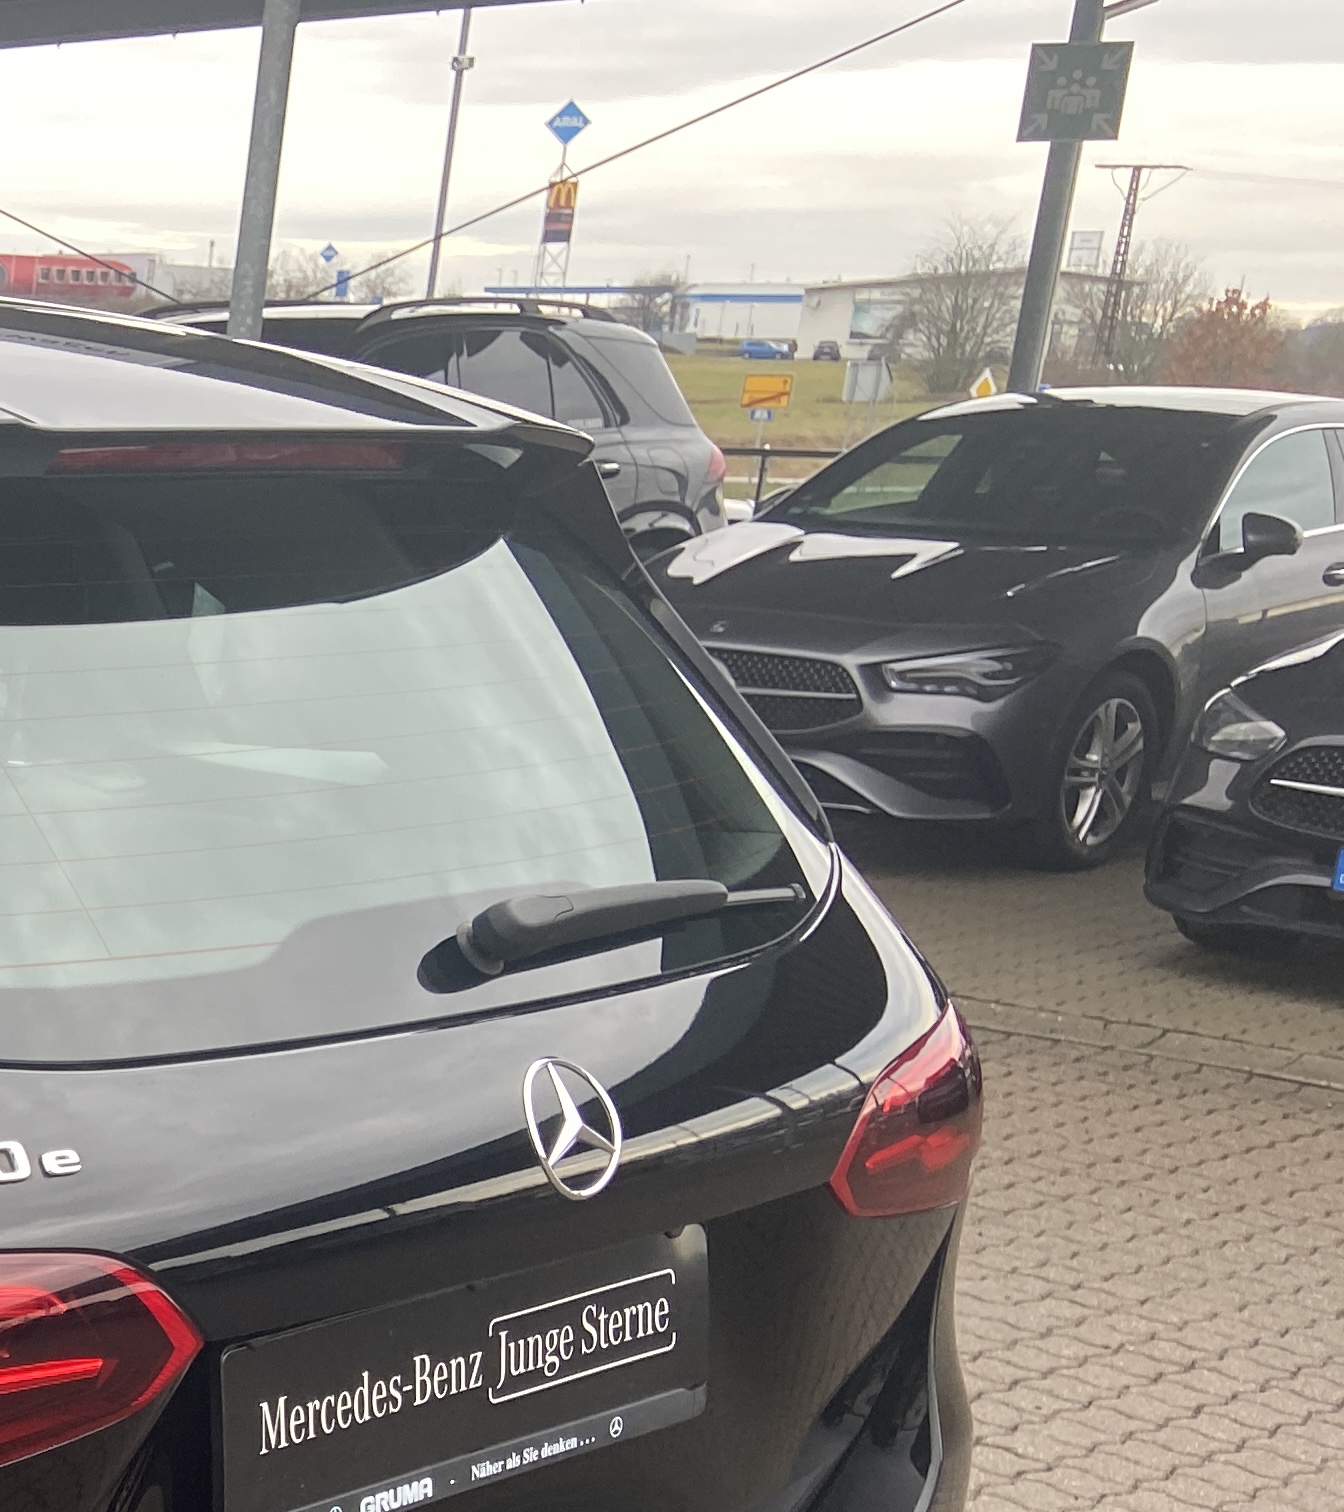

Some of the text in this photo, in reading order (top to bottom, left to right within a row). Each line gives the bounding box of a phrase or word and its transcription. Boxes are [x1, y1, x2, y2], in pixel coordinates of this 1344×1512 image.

[259, 1296, 671, 1455] Mercedes-Benz Junge Sterne
[470, 1460, 505, 1481] Näher
[506, 1451, 521, 1470] als
[523, 1446, 539, 1466] Sie
